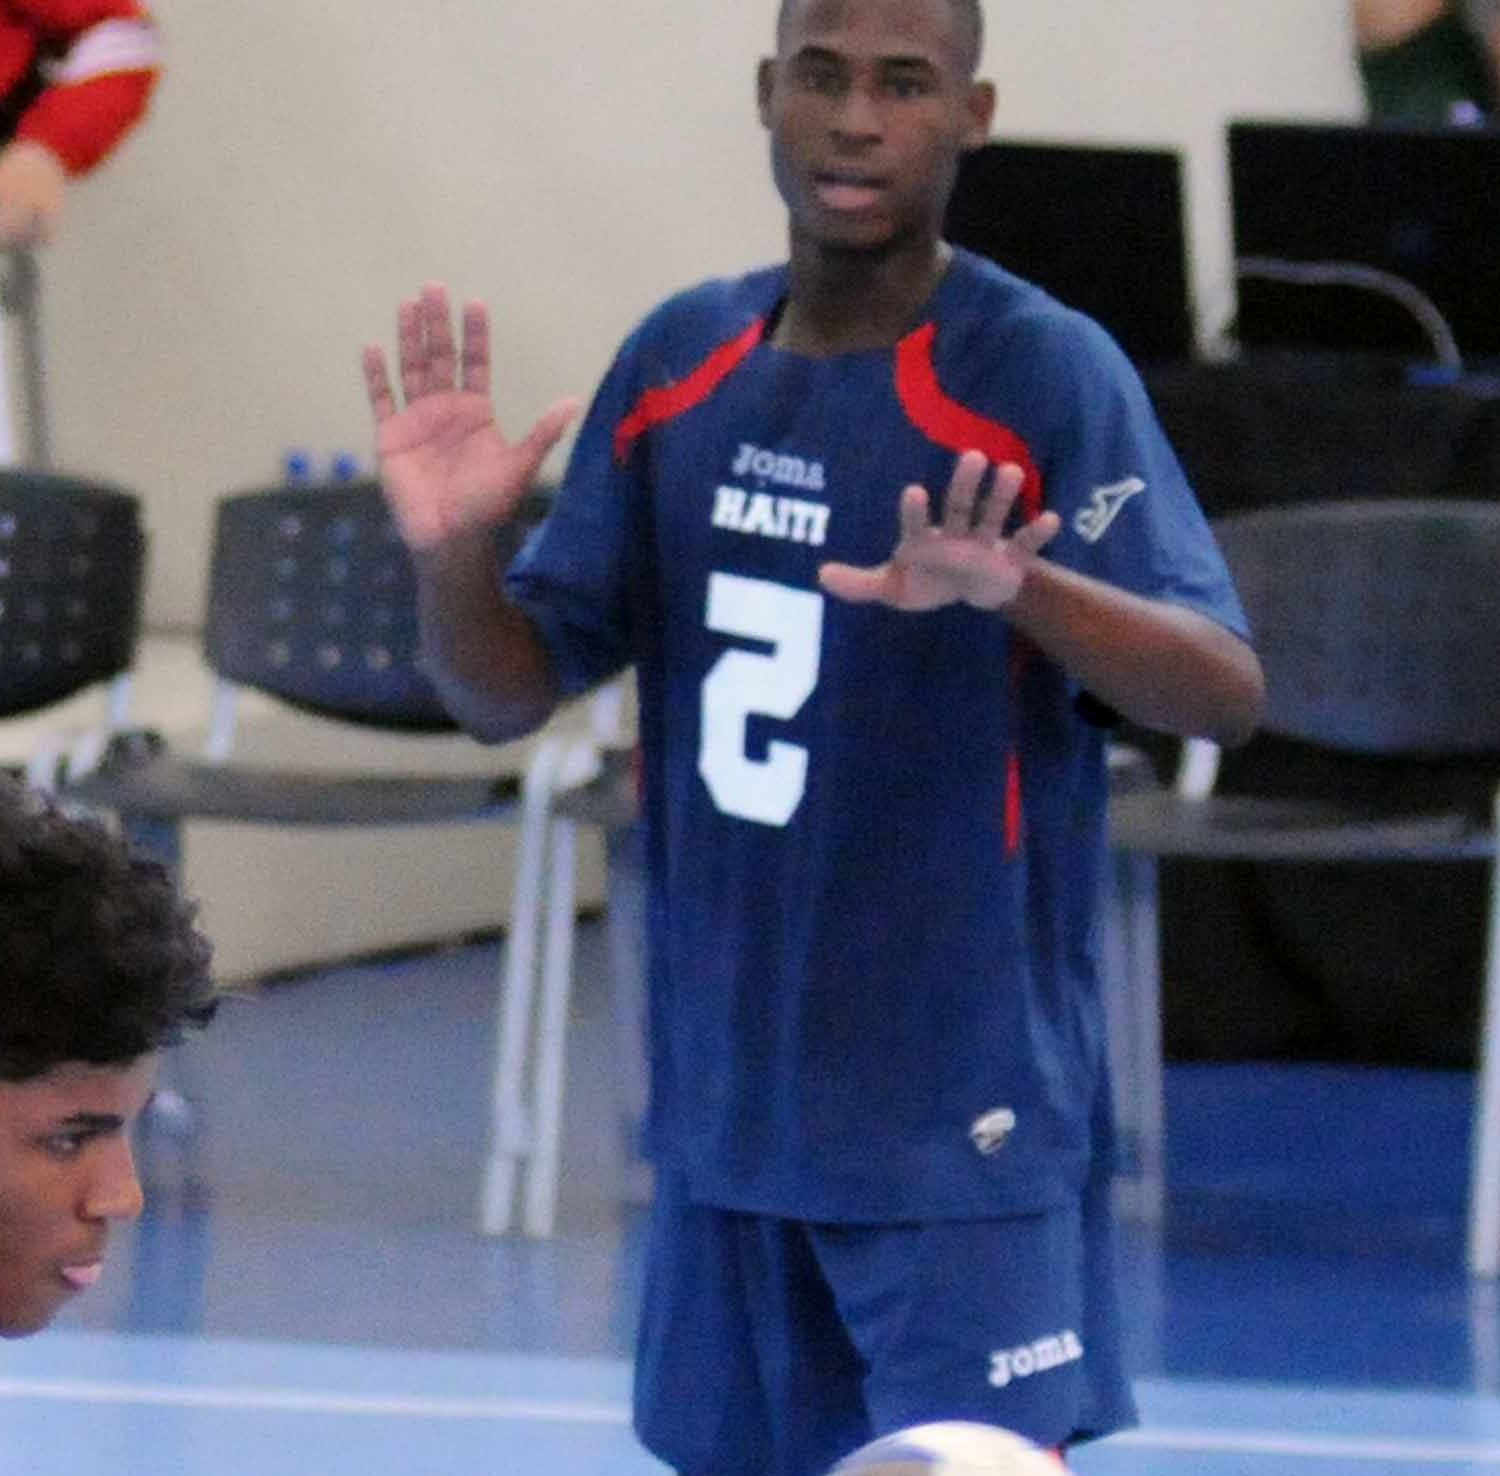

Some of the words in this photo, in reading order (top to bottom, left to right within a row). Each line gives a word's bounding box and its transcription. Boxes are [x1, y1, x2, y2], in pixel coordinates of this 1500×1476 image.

[711, 488, 830, 546] HAITI
[699, 572, 824, 827] 2
[988, 1329, 1083, 1387] Joma
